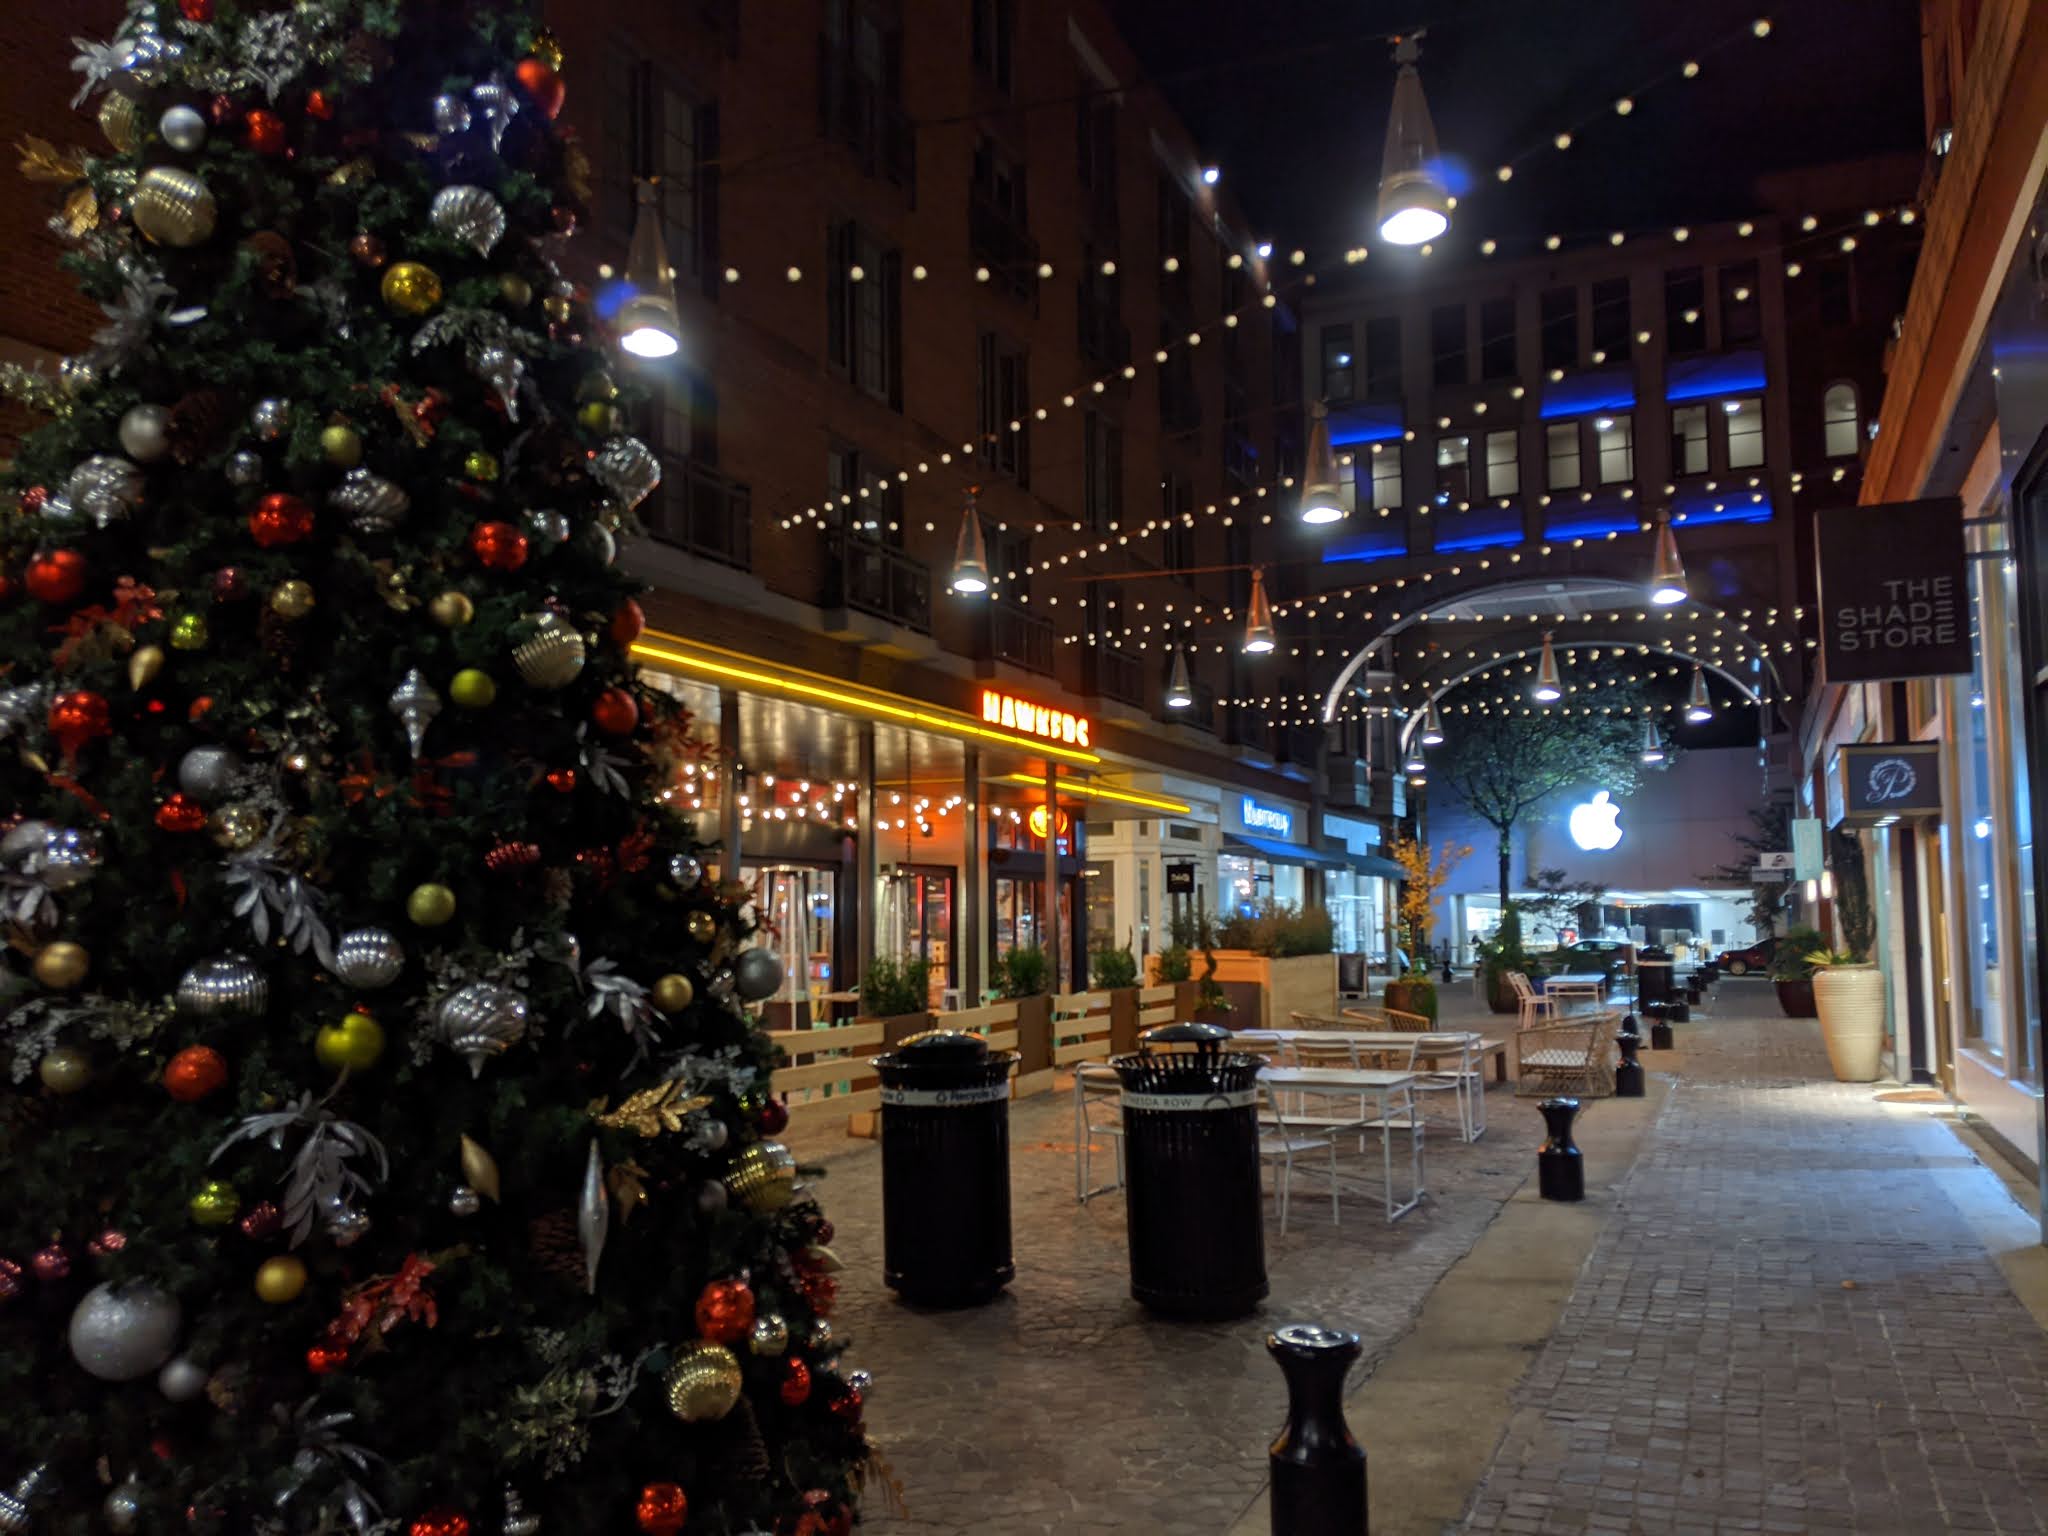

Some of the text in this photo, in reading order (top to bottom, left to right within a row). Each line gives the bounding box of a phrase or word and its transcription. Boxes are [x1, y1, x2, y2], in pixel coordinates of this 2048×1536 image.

[1882, 576, 1953, 601] THE
[1837, 600, 1954, 628] SHADE
[1839, 623, 1957, 651] STORE
